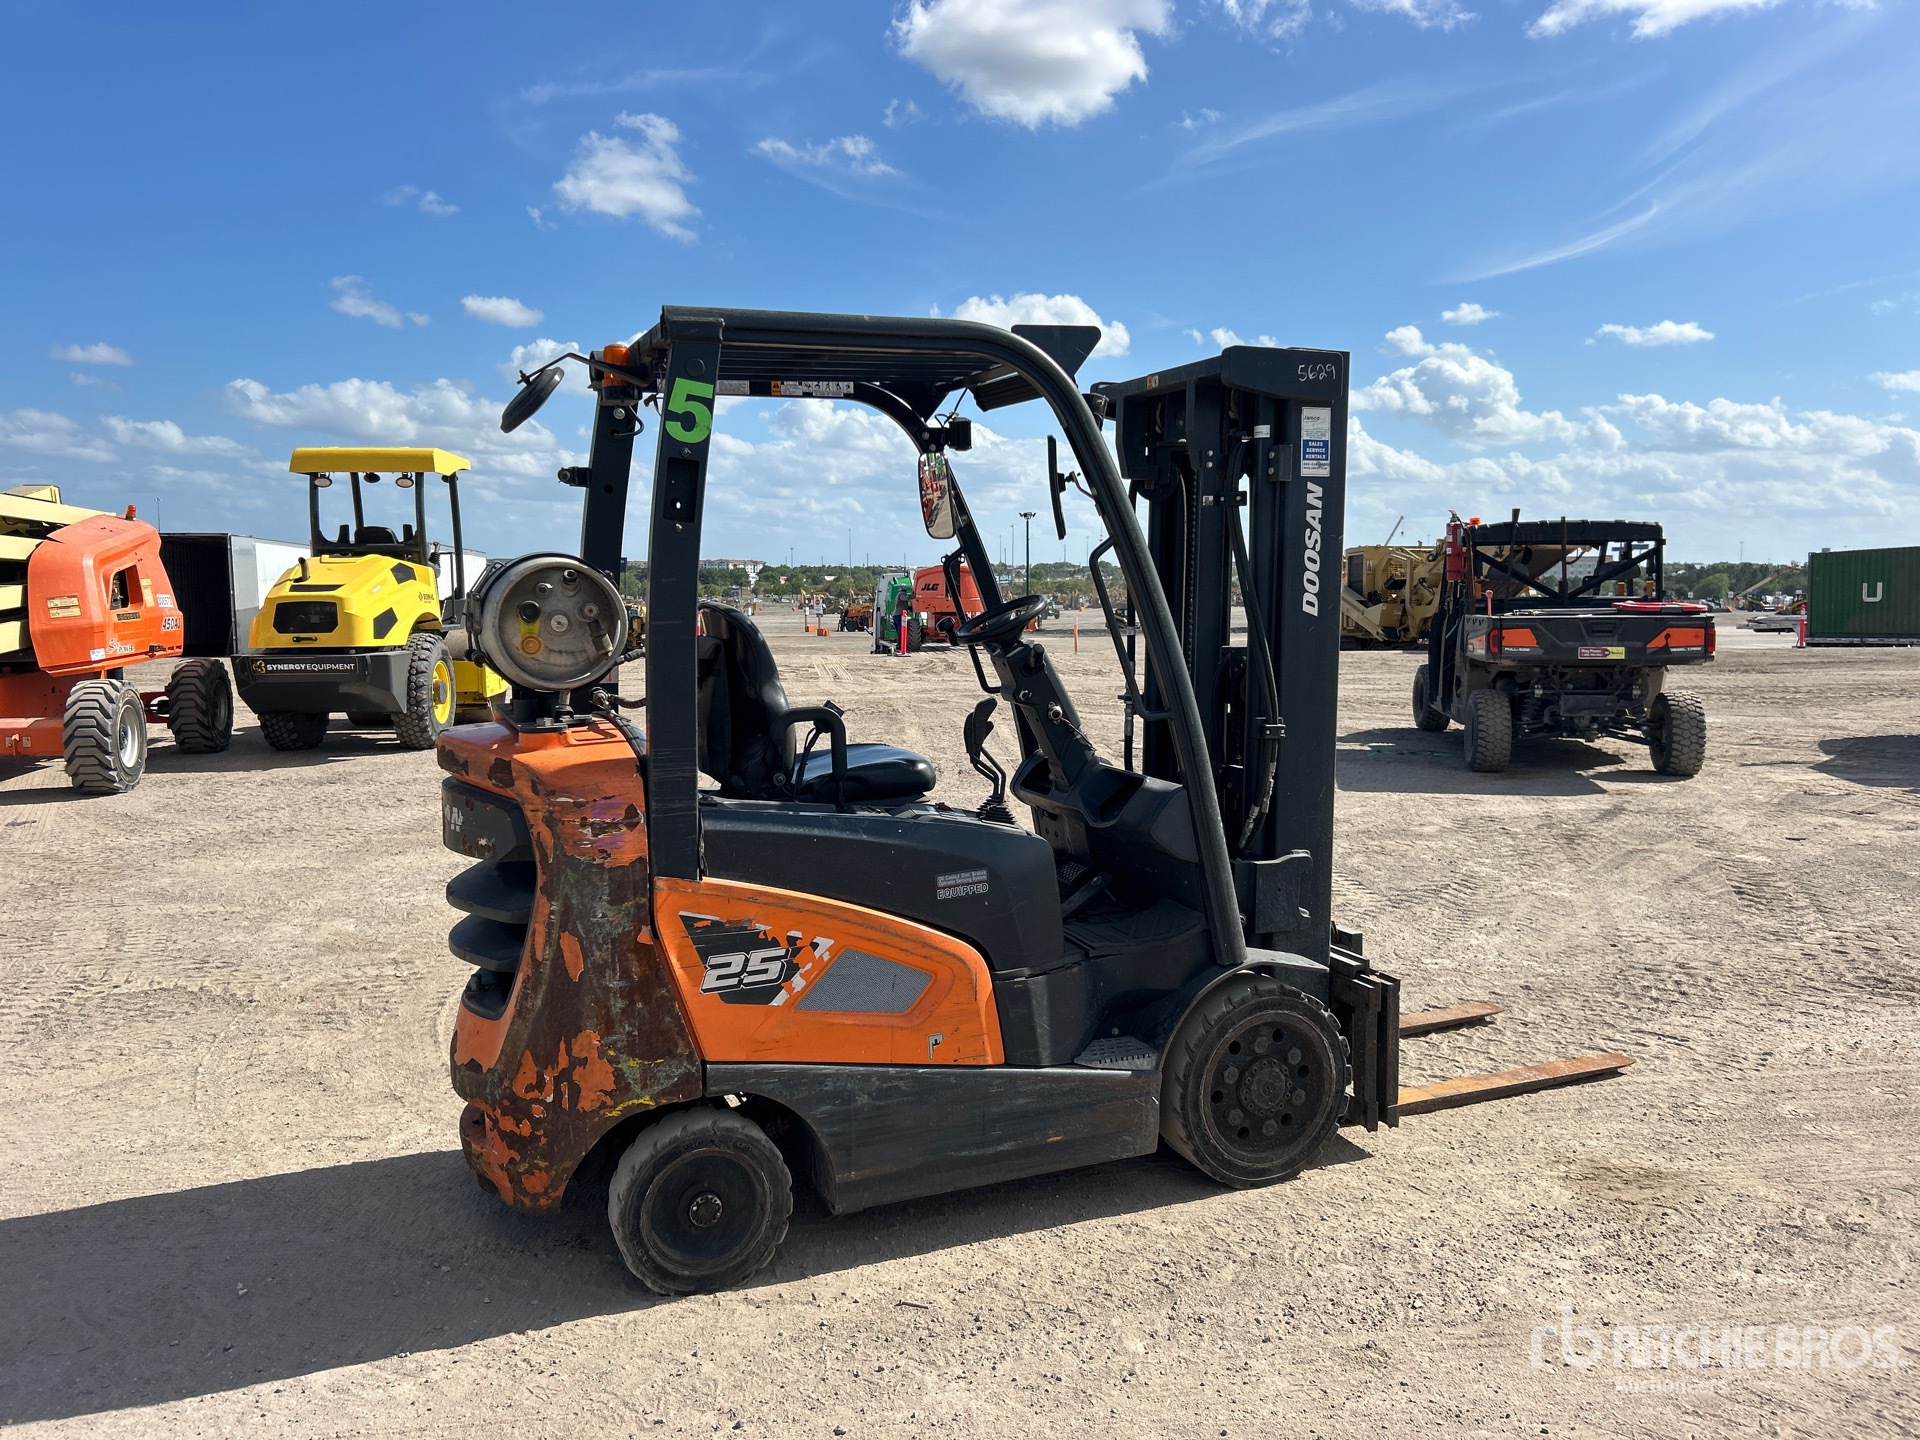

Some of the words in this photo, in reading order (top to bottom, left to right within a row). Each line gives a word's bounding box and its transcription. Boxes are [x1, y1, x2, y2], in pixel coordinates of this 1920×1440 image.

[1298, 364, 1335, 382] 5629
[665, 377, 714, 444] 5
[1302, 481, 1323, 617] DOOSAN
[921, 583, 940, 591] JLG
[1862, 582, 1883, 602] U
[266, 663, 305, 671] SYNERGY
[306, 663, 355, 671] EQUIPMENT
[936, 883, 989, 900] EQUIPPED
[700, 948, 791, 994] 25
